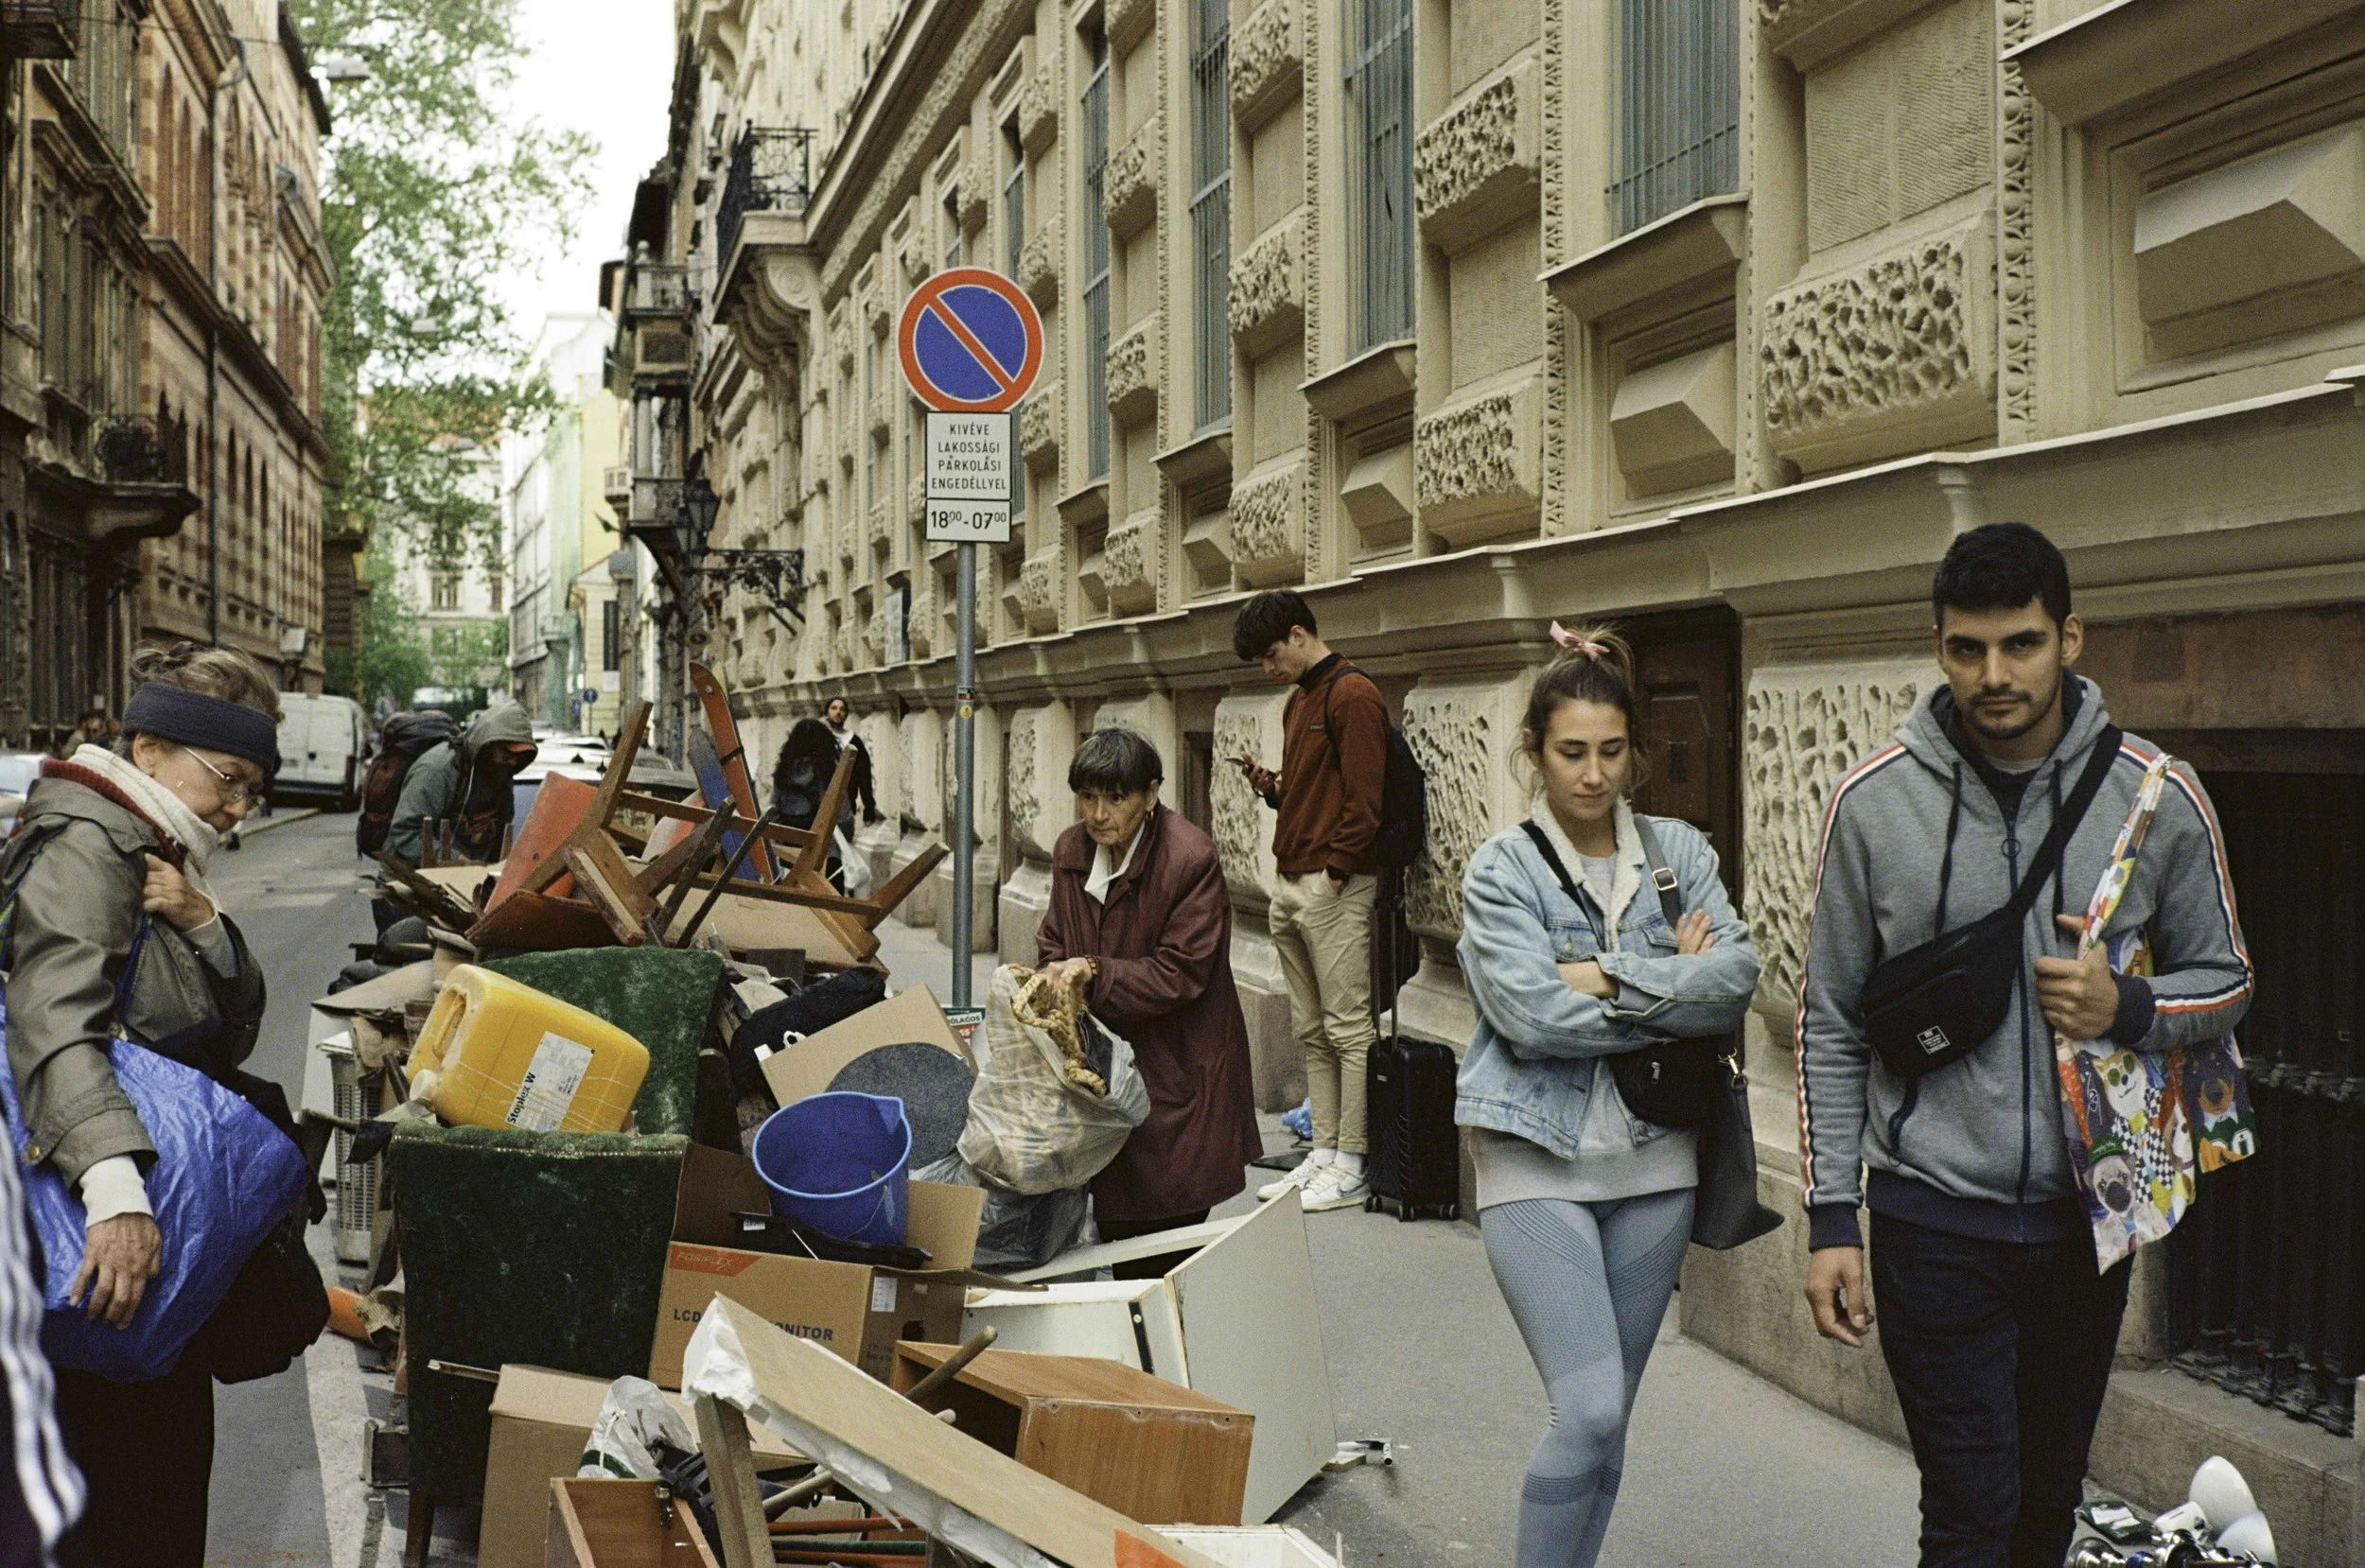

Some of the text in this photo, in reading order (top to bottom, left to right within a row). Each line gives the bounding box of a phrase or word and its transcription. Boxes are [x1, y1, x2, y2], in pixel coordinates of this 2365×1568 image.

[950, 422, 990, 435] KIVÉVE
[938, 440, 1000, 453] LAKOSSÁGI
[932, 476, 1007, 490] ENGEDÉLLYEL
[507, 1071, 535, 1124] Stoplex W
[674, 1309, 833, 1340] LCD NITOR
